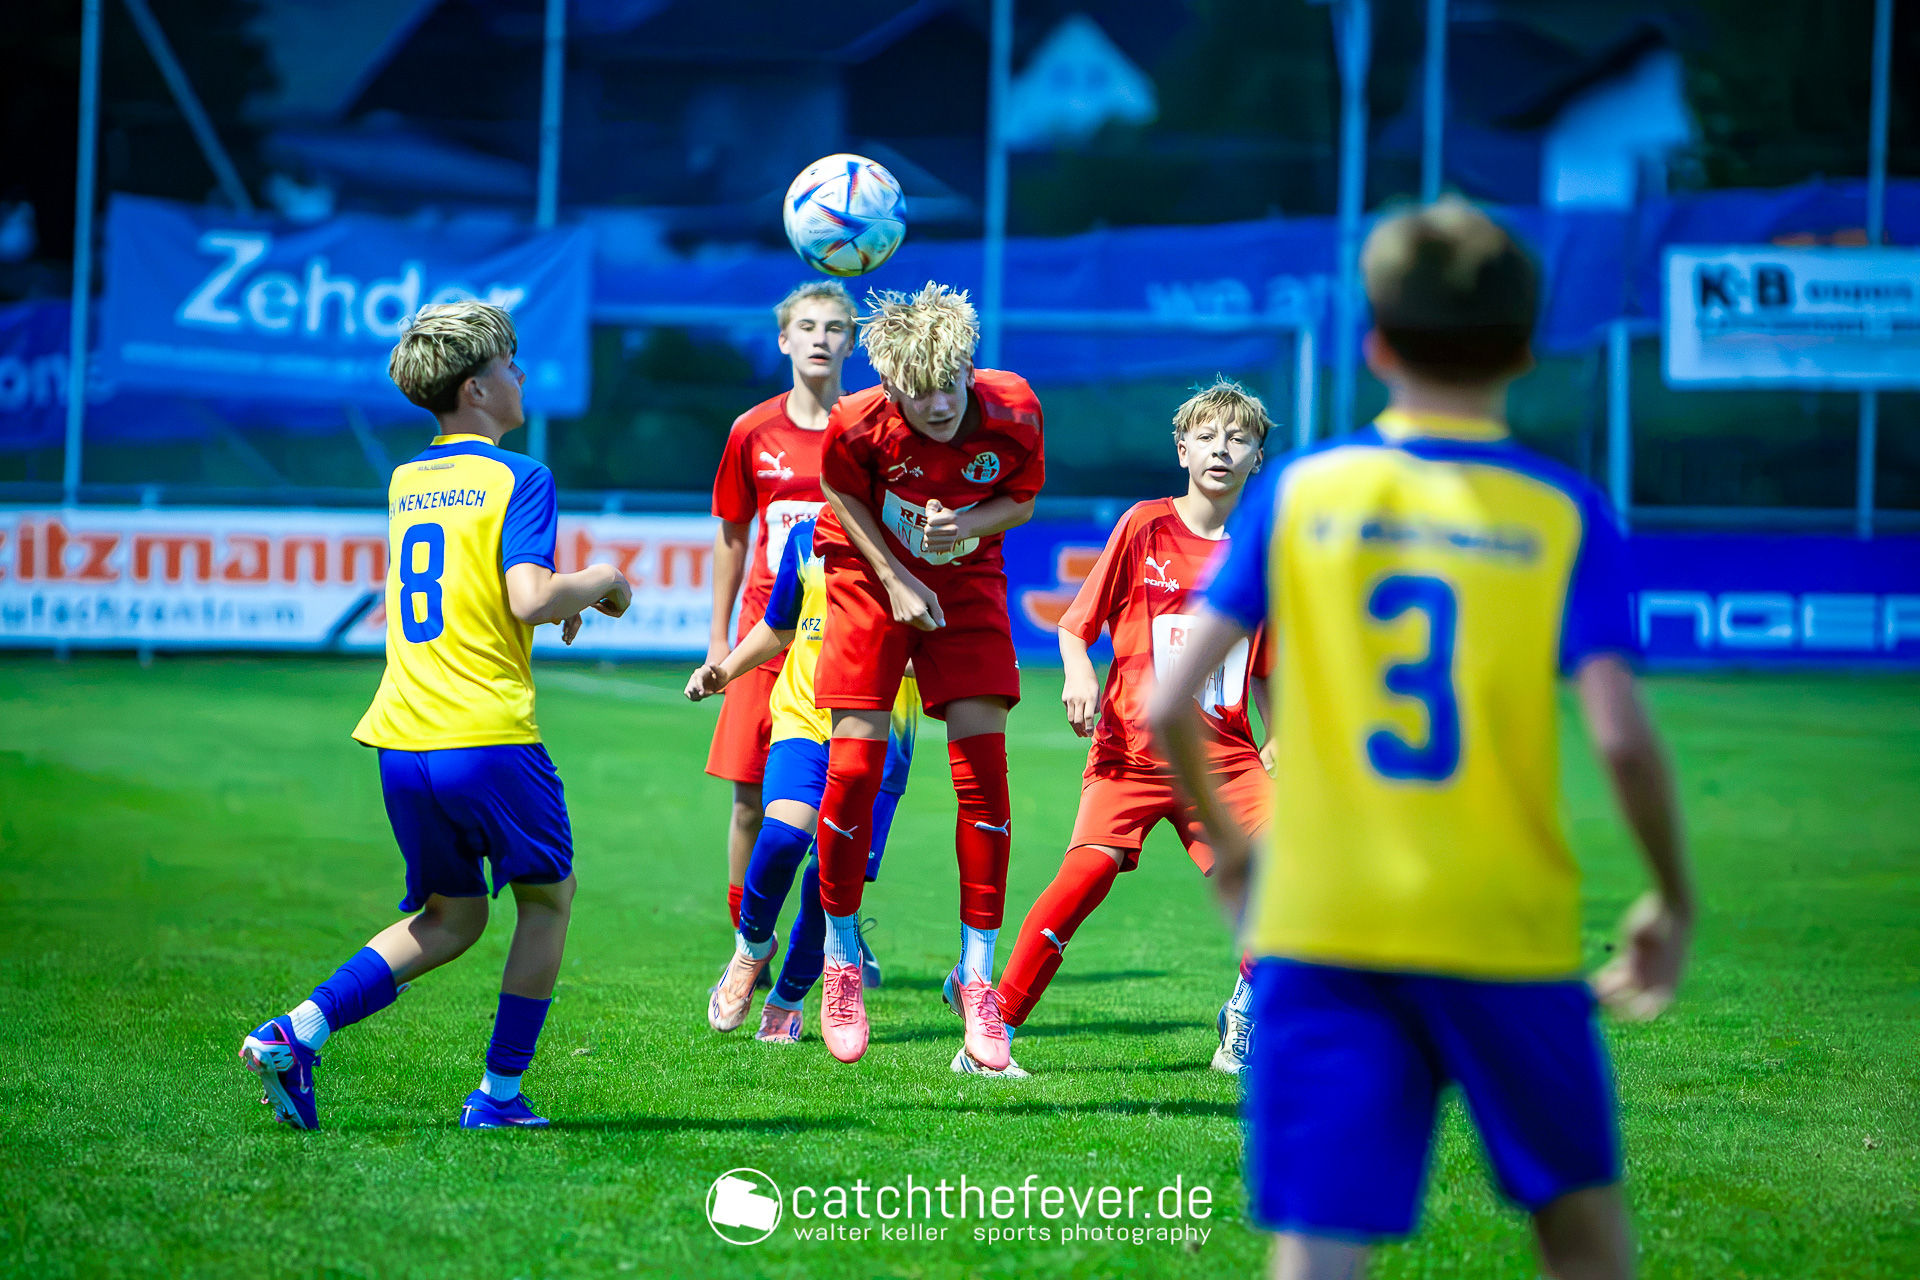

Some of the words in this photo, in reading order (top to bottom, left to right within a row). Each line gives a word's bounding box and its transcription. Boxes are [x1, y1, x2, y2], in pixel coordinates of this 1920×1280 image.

[399, 489, 487, 514] WENZENBACH
[0, 518, 388, 585] itzmann
[400, 522, 445, 645] 8
[802, 617, 821, 631] KFZ
[1367, 574, 1460, 783] 3
